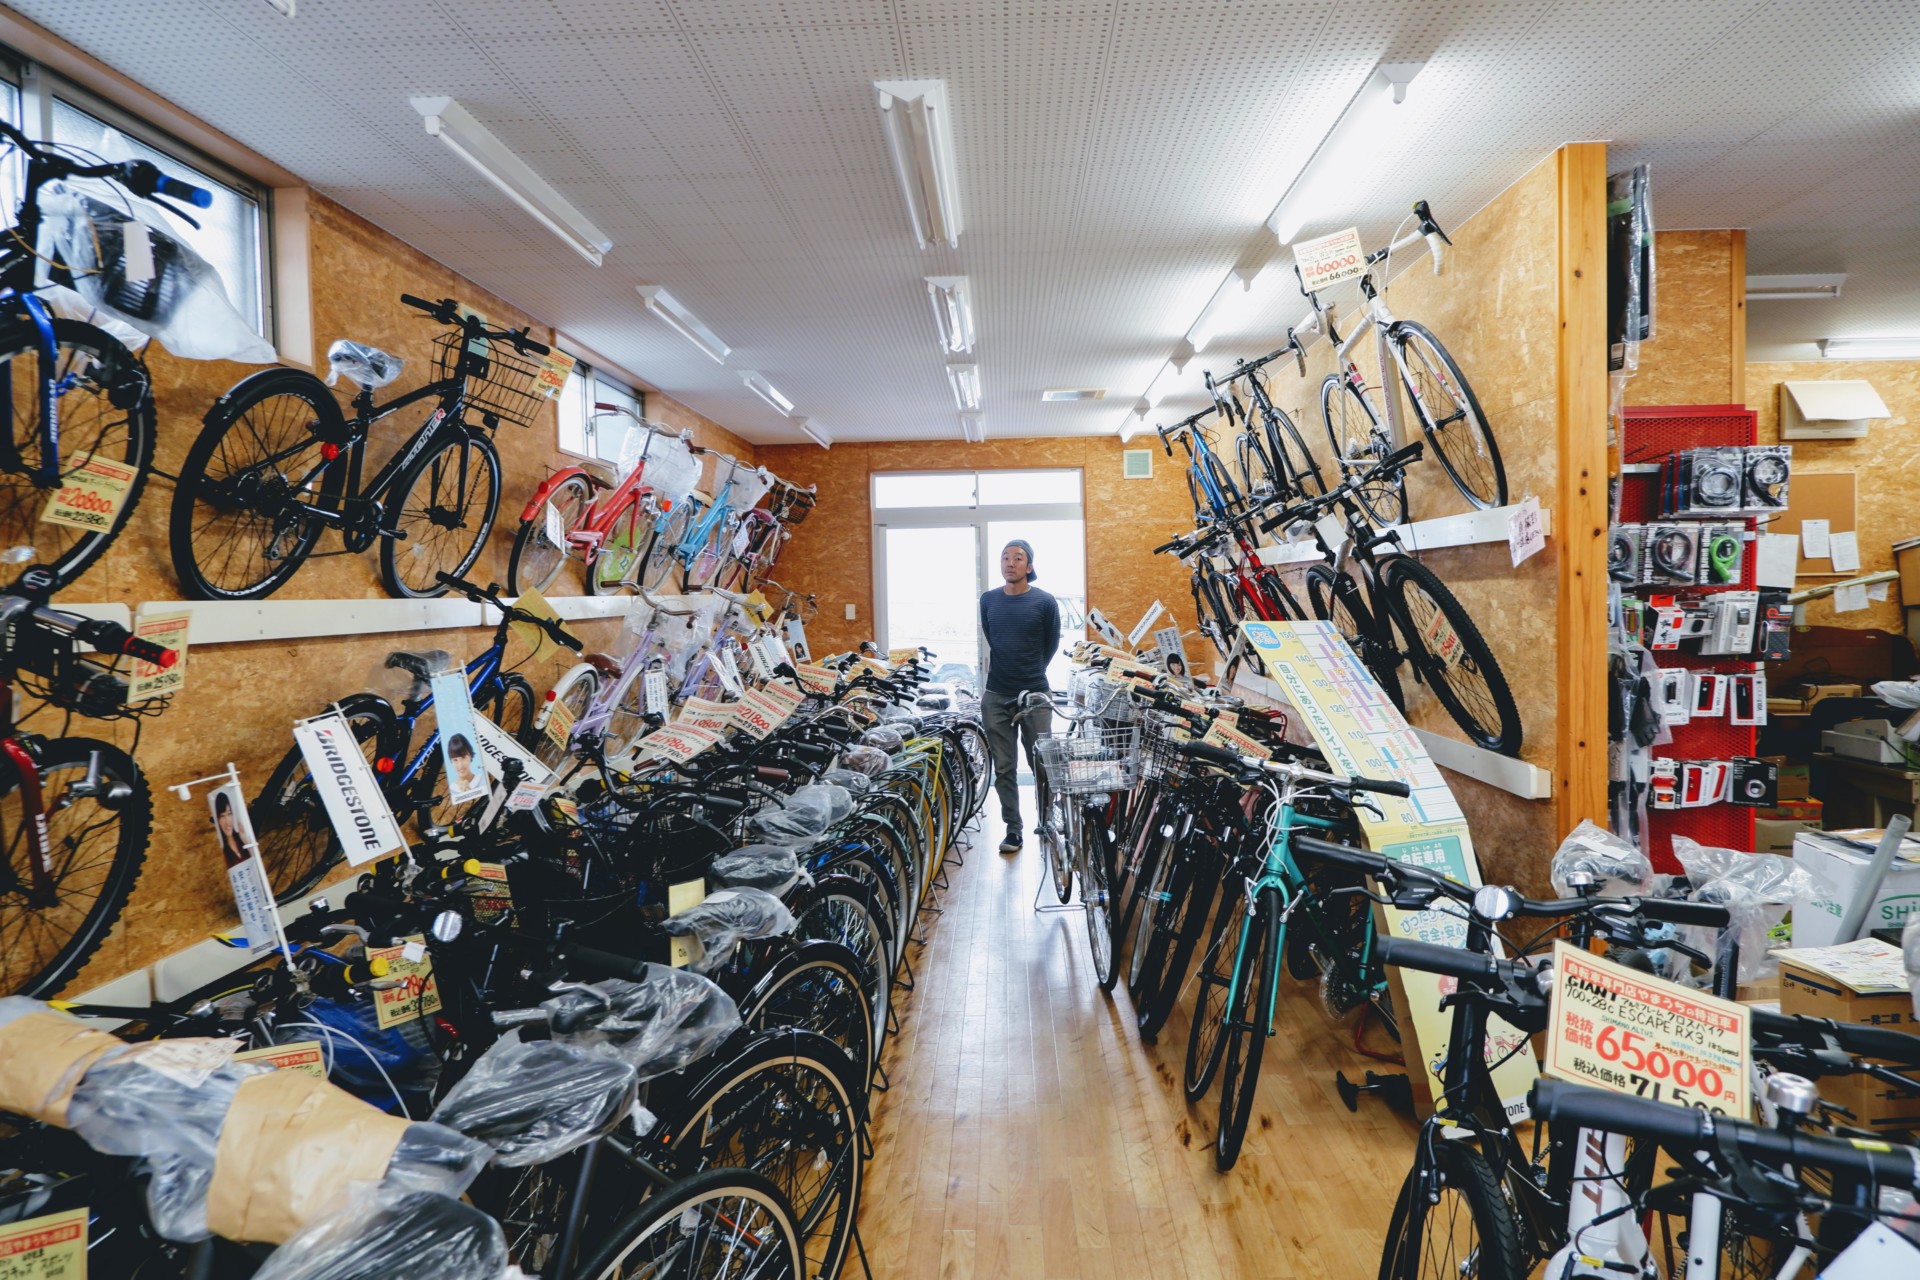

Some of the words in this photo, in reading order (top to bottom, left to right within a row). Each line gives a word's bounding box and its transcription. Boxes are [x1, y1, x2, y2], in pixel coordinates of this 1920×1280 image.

[1316, 254, 1356, 275] 60000
[1329, 267, 1359, 281] 66000
[66, 487, 112, 513] 20800
[1279, 631, 1295, 640] 150
[1295, 654, 1311, 663] 140
[1312, 679, 1328, 688] 130
[741, 708, 770, 730] 21800
[1329, 704, 1346, 714] 120
[1348, 730, 1364, 740] 110
[1366, 758, 1382, 768] 100
[314, 729, 382, 851] BRIDGESTONE
[1401, 812, 1414, 823] 80
[1400, 848, 1446, 867] 自転車用
[1567, 975, 1618, 1002] GIANT
[1567, 962, 1733, 1030] 自転車専門店やまうちの特選車
[1565, 1011, 1594, 1033] 税抜
[1618, 1004, 1671, 1034] ESCAPE
[1675, 1024, 1704, 1045] RX3
[1565, 1028, 1593, 1050] 価格
[1596, 1025, 1723, 1097] 65000
[1573, 1056, 1626, 1088] 税込価格
